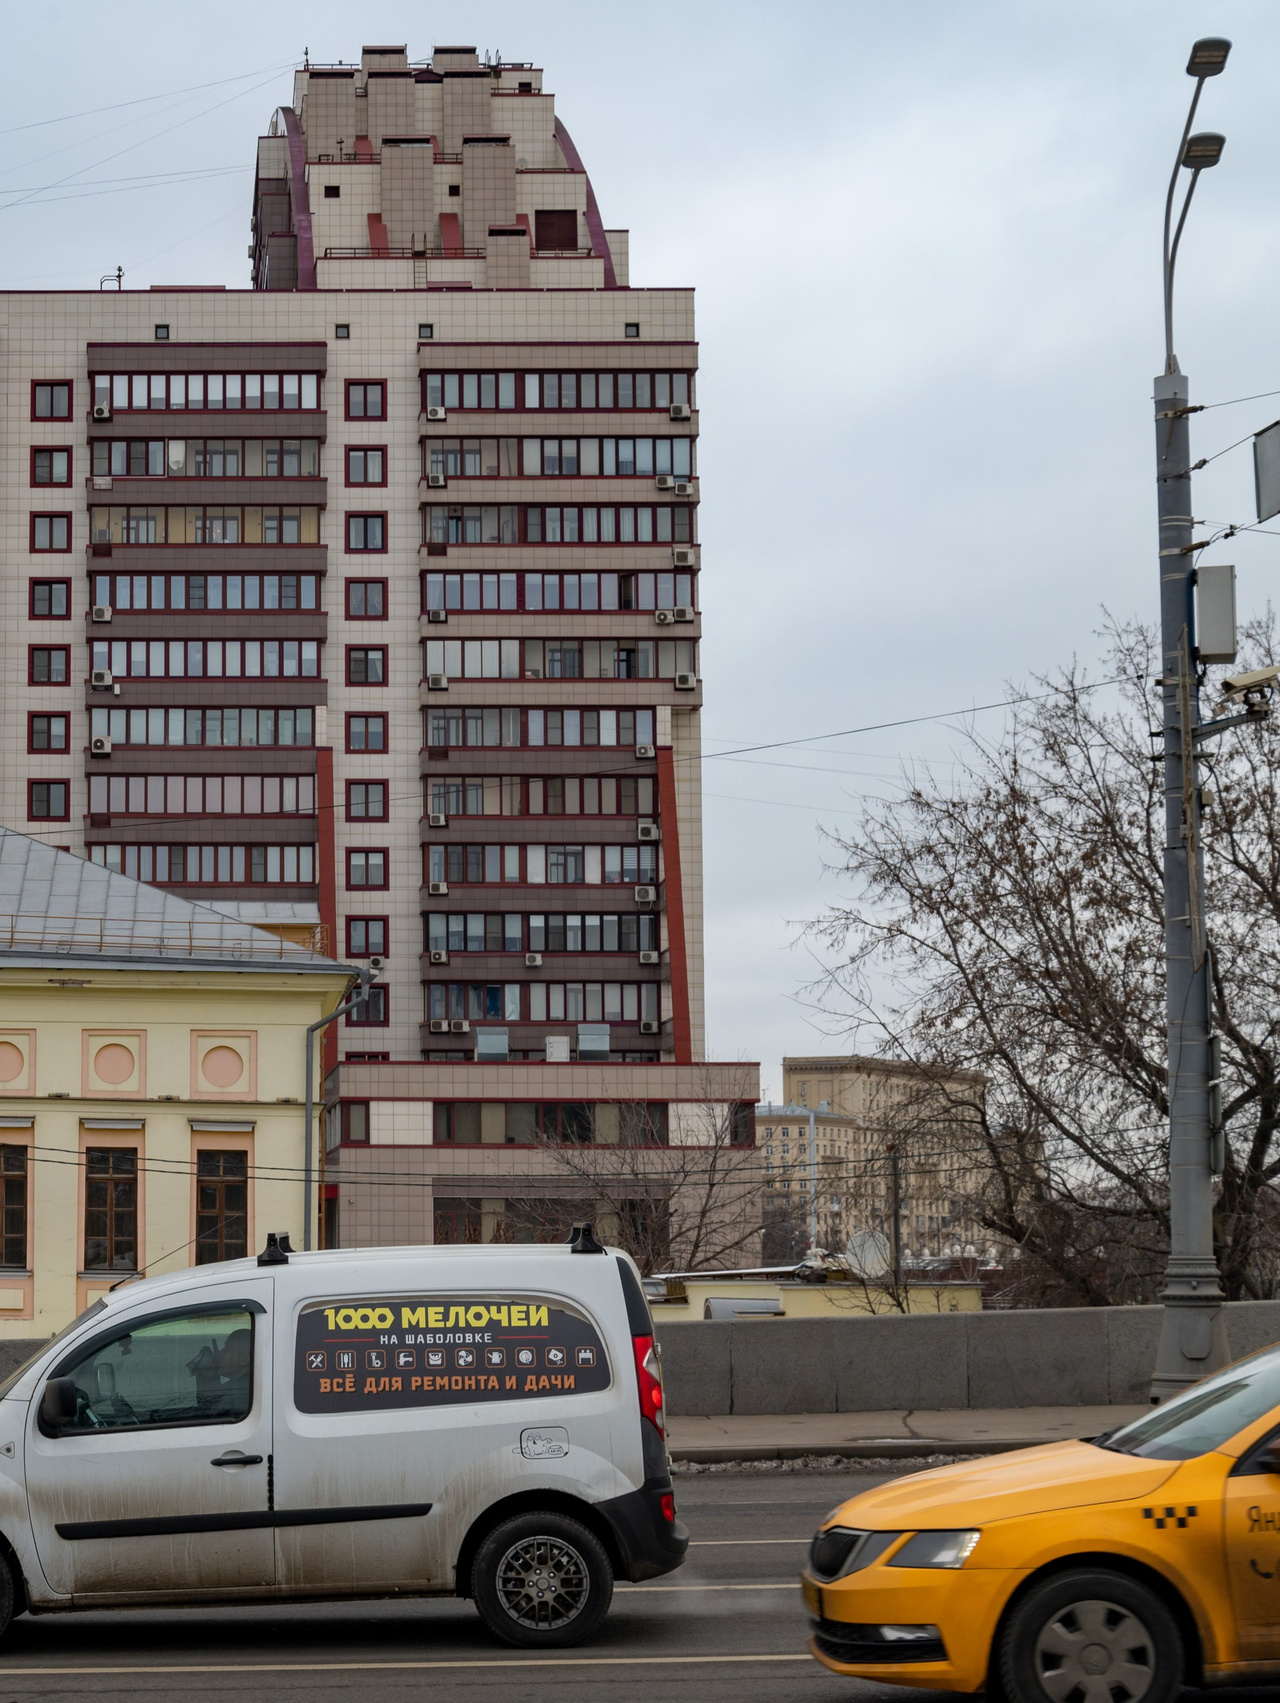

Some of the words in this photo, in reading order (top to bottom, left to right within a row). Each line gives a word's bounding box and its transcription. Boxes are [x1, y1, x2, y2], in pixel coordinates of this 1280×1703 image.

[323, 1308, 395, 1330] 1000
[380, 1335, 398, 1345] НА
[405, 1332, 493, 1344] ШАБОЛОВКЕ
[319, 1373, 357, 1393] ВСЁ
[363, 1376, 403, 1394] ДЛЯ
[411, 1375, 500, 1391] РЕМОНТА
[505, 1375, 517, 1391] И
[524, 1374, 576, 1392] ДАЧИ
